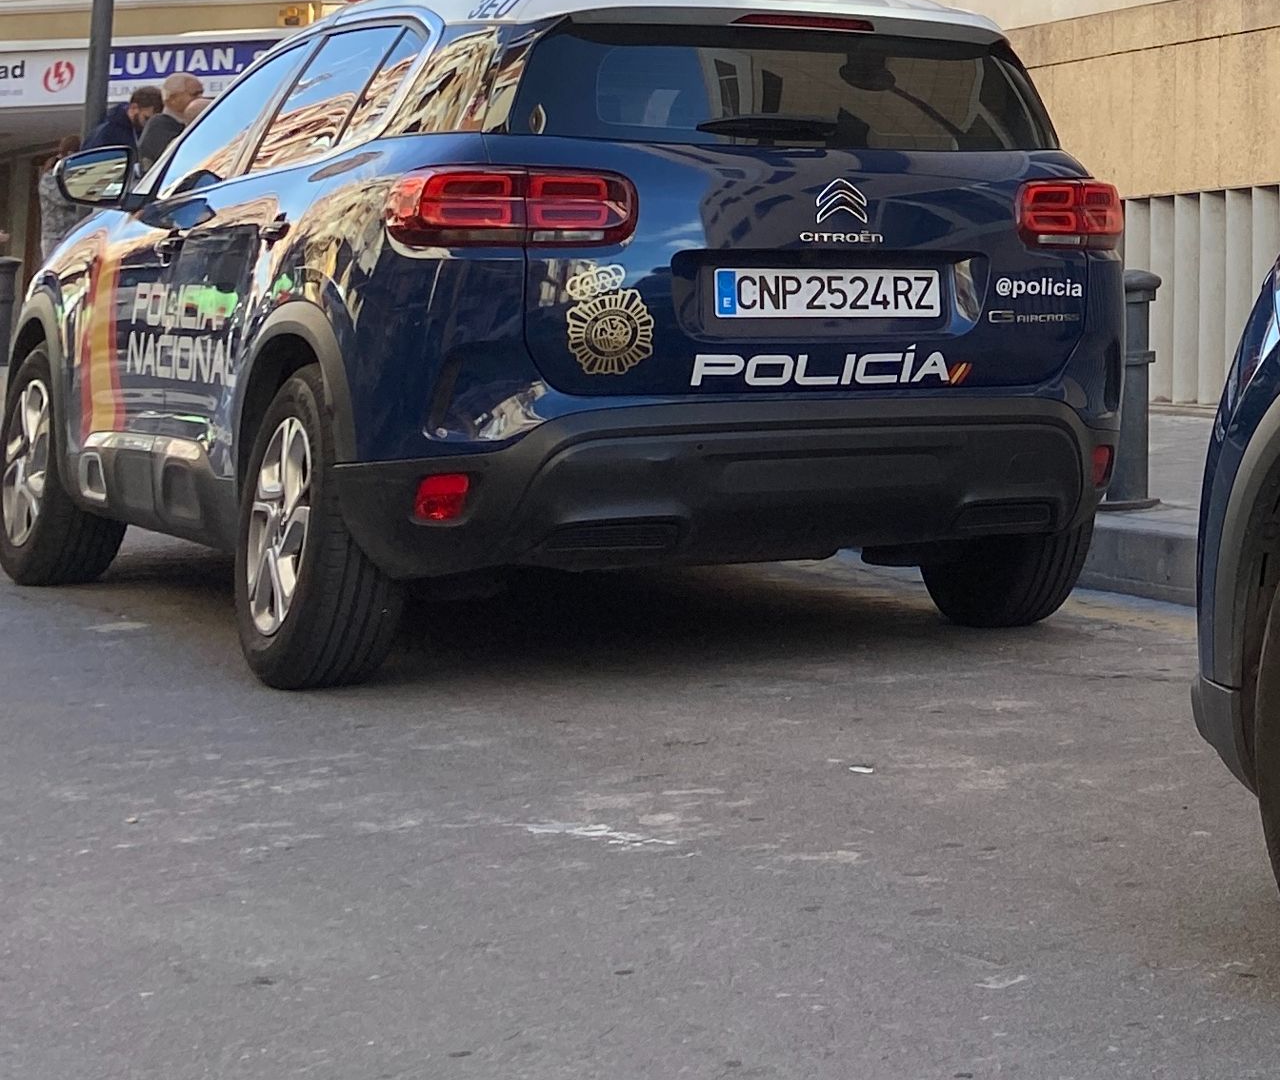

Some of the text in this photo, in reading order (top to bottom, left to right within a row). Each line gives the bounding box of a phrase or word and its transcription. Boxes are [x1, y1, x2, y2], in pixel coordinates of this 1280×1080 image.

[799, 230, 883, 243] CITROËN
[995, 277, 1082, 298] @policia
[126, 330, 238, 388] NACIONAL
[690, 344, 950, 386] POLICÍA
